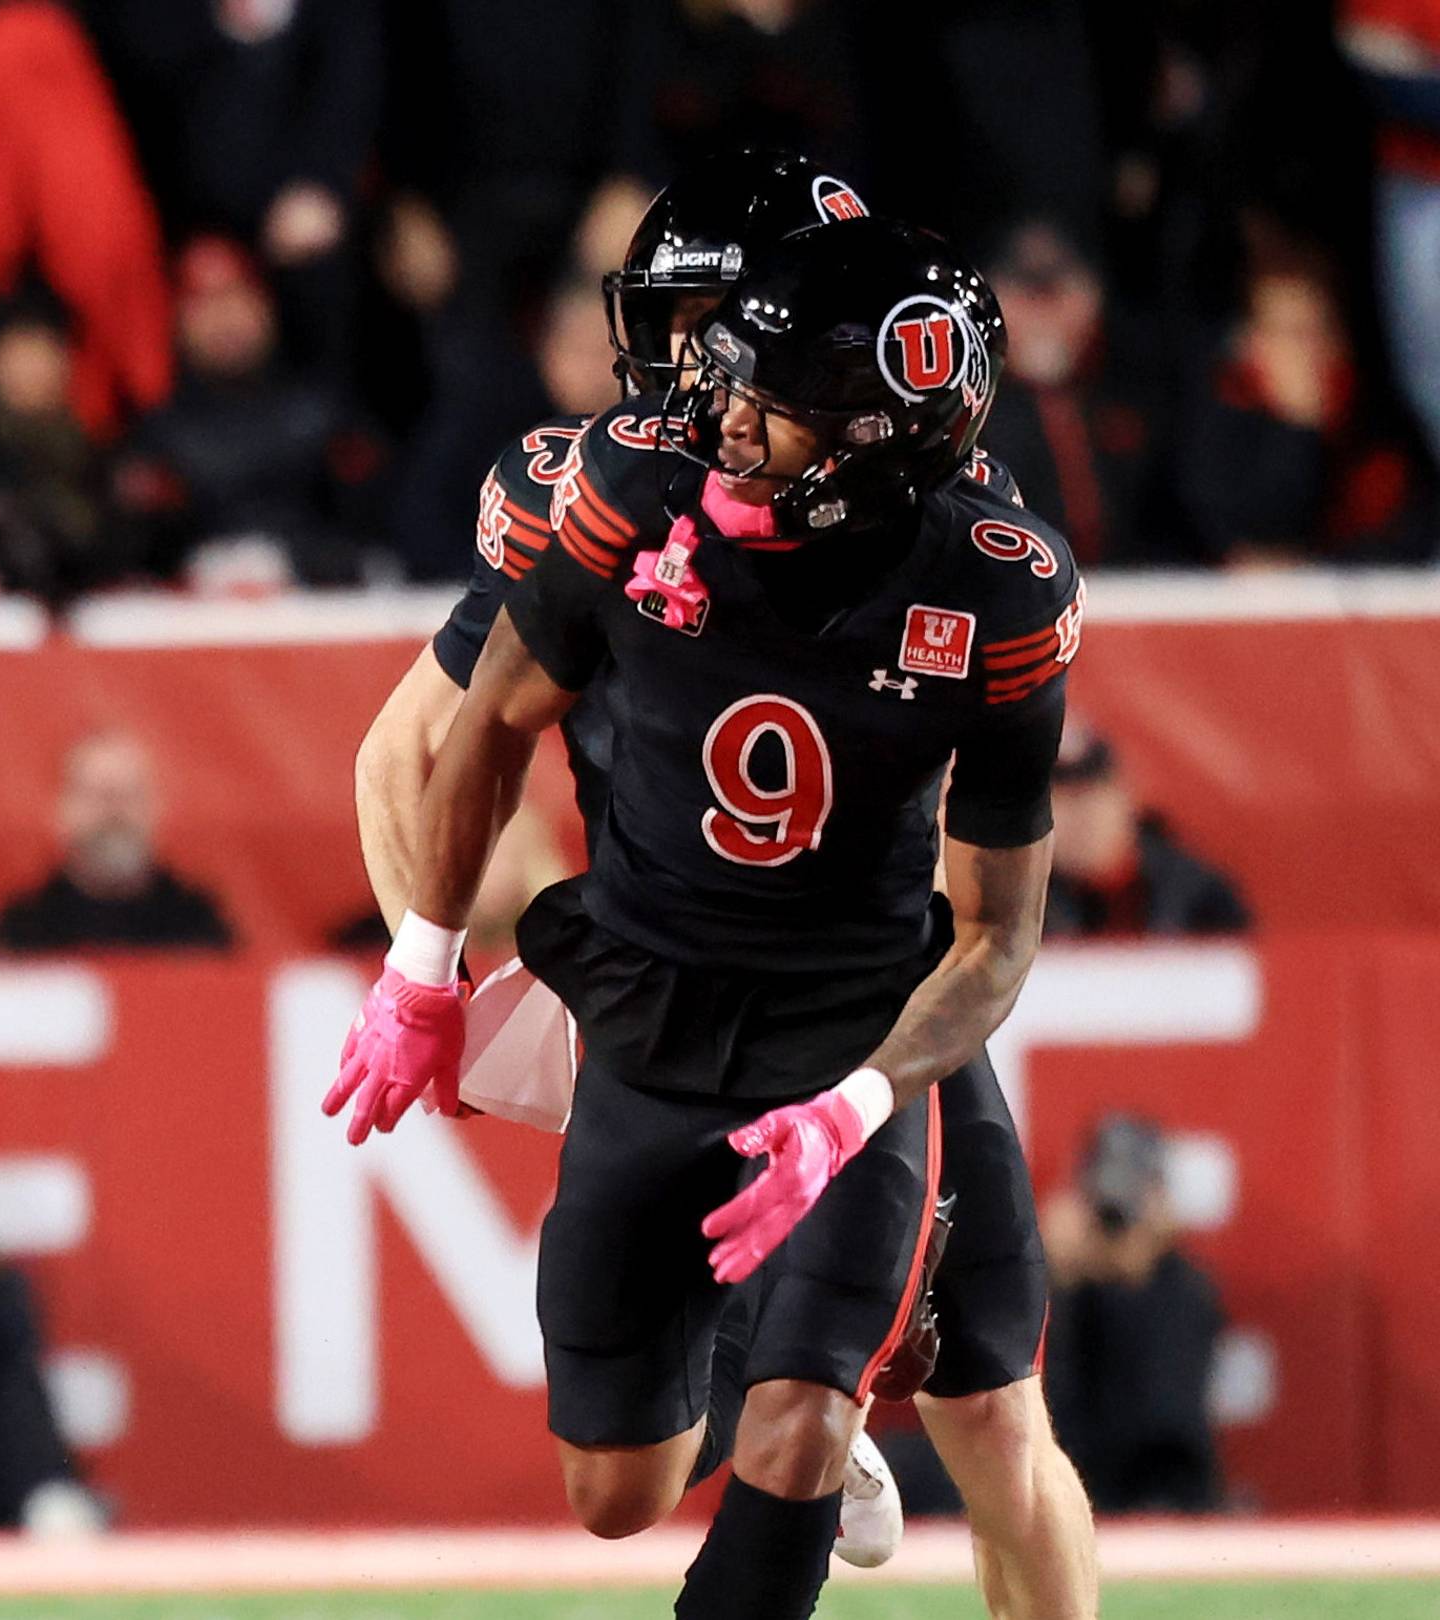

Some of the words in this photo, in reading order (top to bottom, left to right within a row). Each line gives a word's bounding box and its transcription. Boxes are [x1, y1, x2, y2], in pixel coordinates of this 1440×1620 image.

[893, 314, 954, 391] U
[971, 519, 1059, 580] 9
[906, 645, 963, 667] HEALTH
[701, 693, 833, 868] 9
